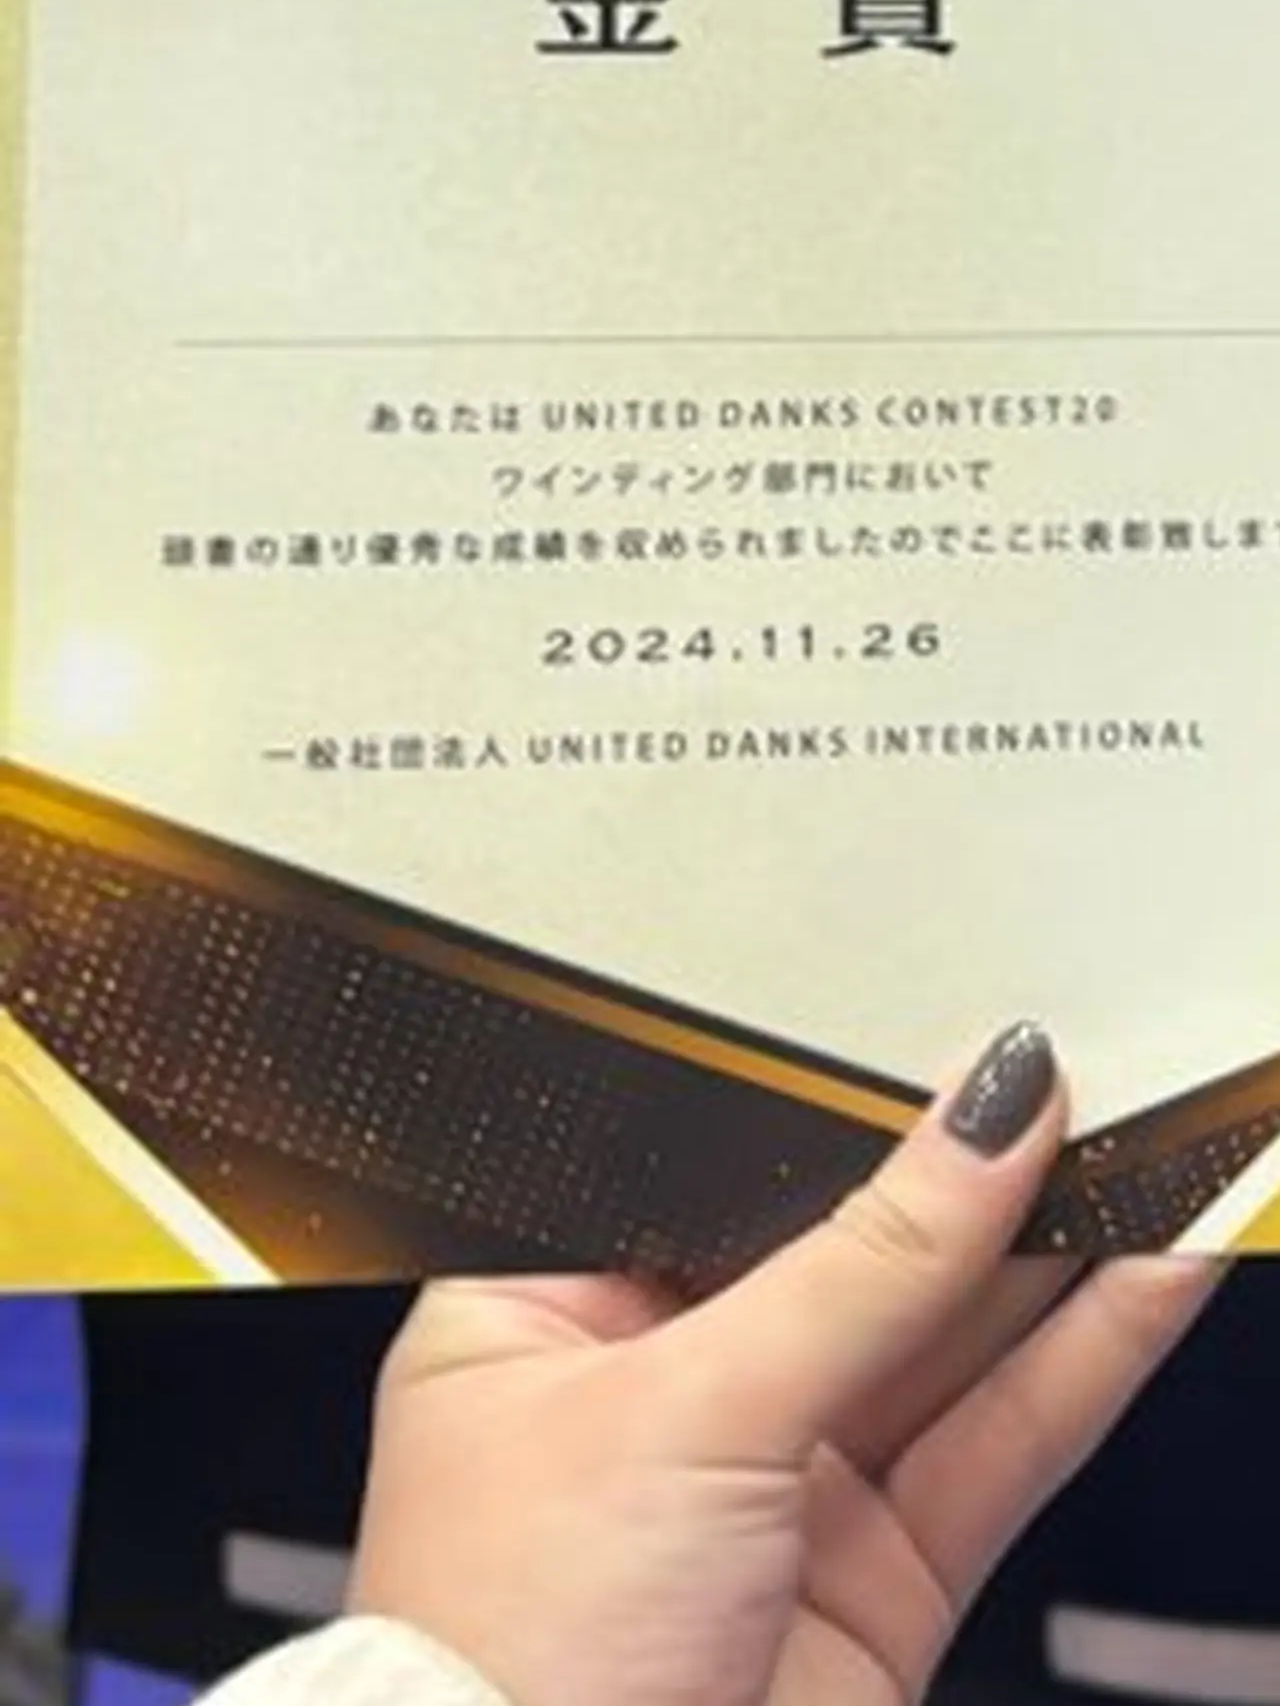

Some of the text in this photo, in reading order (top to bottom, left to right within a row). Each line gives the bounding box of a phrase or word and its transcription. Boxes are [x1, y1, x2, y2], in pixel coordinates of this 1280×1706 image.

[368, 396, 1115, 434] あなたは UNITED DANKS CONTEST20
[494, 460, 991, 497] ワインディング部門において
[542, 623, 940, 666] 2024.11.26
[263, 720, 1202, 771] 一般社団法人 UNITED DANKS INTERNATIONAL
